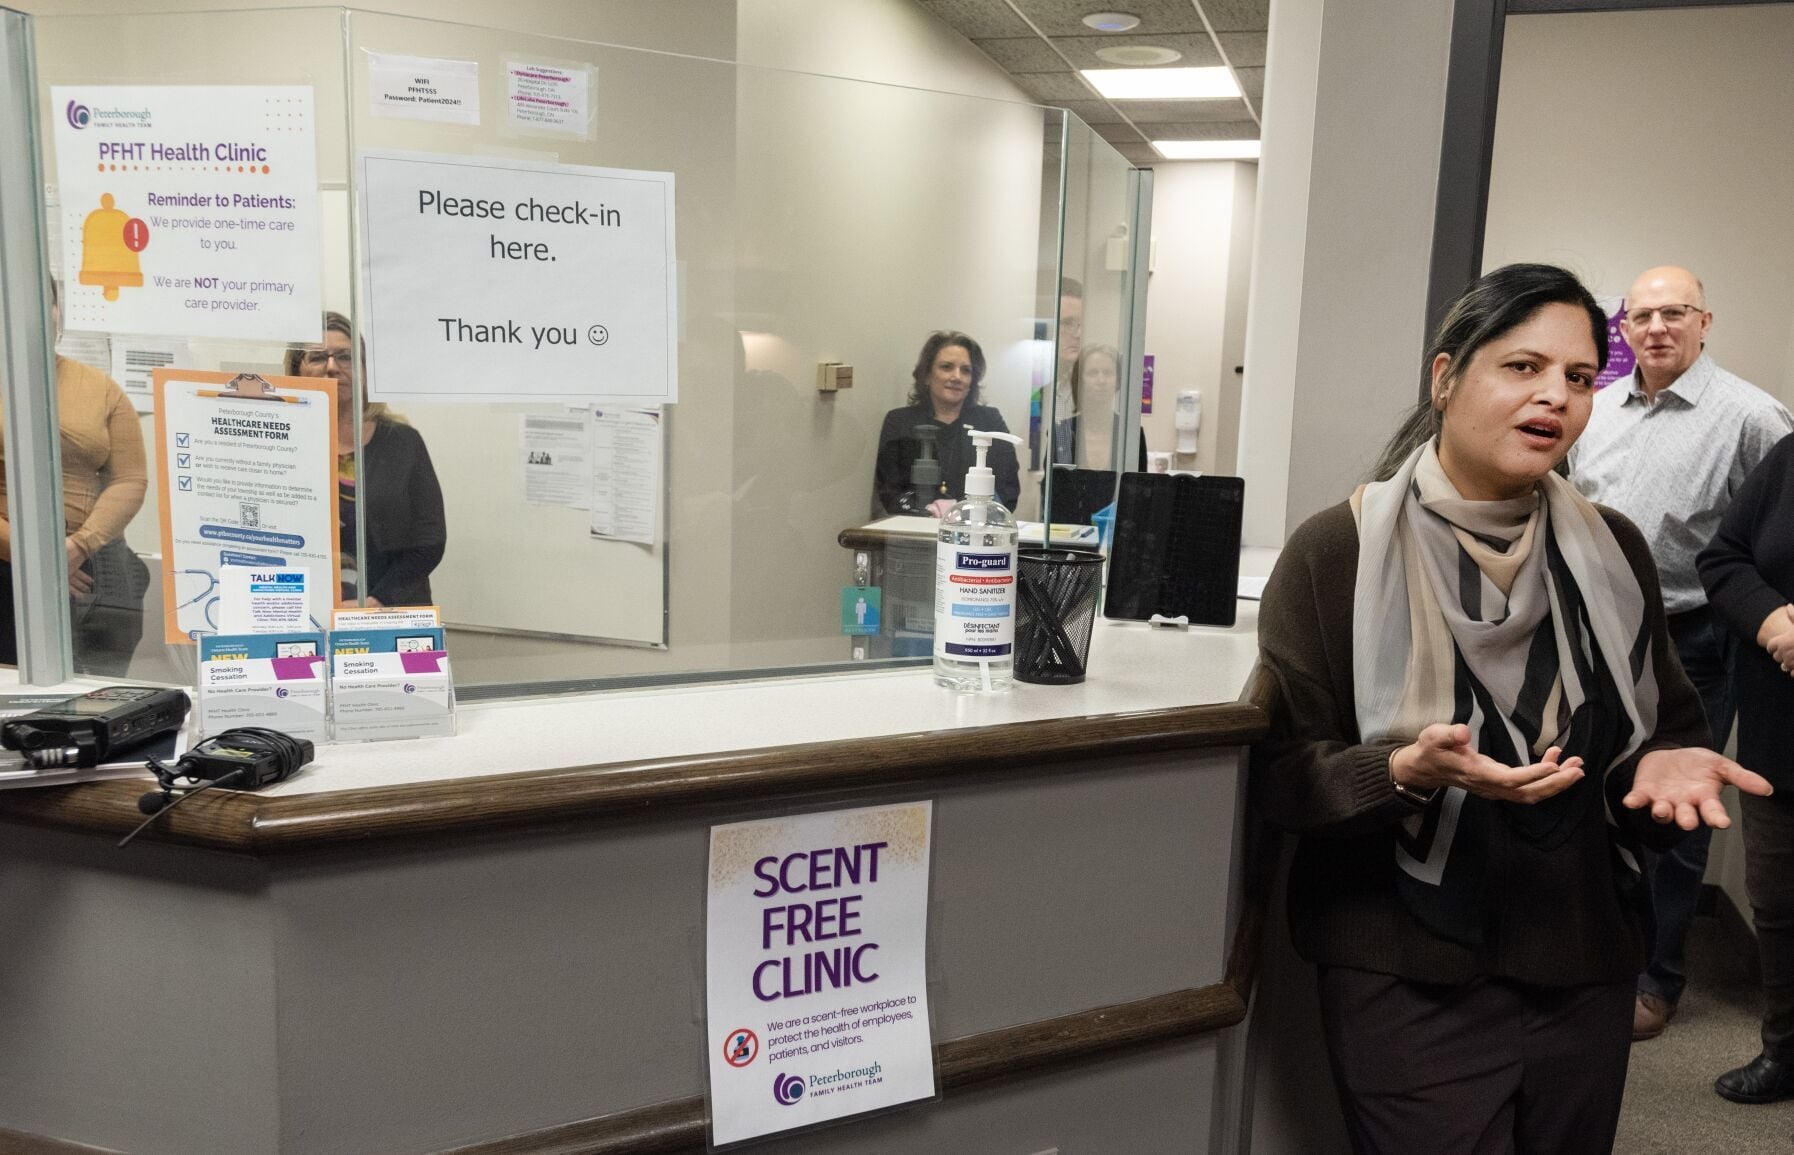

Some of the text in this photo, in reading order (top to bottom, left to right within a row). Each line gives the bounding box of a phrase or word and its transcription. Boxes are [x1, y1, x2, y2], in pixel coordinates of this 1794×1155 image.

[384, 93, 417, 103] Password:
[93, 107, 151, 121] Peterborough
[99, 142, 267, 162] PFHT Health Clinic
[148, 193, 296, 209] Reminder to Patients:
[418, 190, 621, 227] Please check-in
[150, 216, 295, 231] We provide one-time care
[200, 238, 237, 252] to you.
[490, 234, 556, 261] here.
[153, 275, 294, 295] We are NOT your primary
[184, 298, 260, 312] care provider.
[438, 318, 578, 350] Thank you
[218, 408, 279, 419] Peterborough County's
[211, 417, 291, 431] HEALTHCARE NEEDS
[214, 427, 289, 440] ASSESSMENT FORM
[242, 442, 276, 452] Peterborough
[272, 462, 296, 471] physician
[962, 556, 1006, 568] Pro-guard
[250, 574, 303, 582] TALK NOW
[979, 587, 1006, 595] SANITIZER
[335, 647, 369, 655] NEW
[210, 667, 243, 675] Smoking
[343, 661, 374, 669] Smoking
[752, 841, 888, 898] SCENT
[762, 895, 863, 950] FREE
[752, 943, 879, 1001] CLINIC
[767, 995, 917, 1032] We are a scent-free workplace to
[768, 1010, 913, 1049] protect the health of employees,
[768, 1034, 864, 1064] patients, and visitors.
[809, 1061, 882, 1087] Peterborough
[810, 1077, 883, 1098] FAMILY HEALTH TEAM
